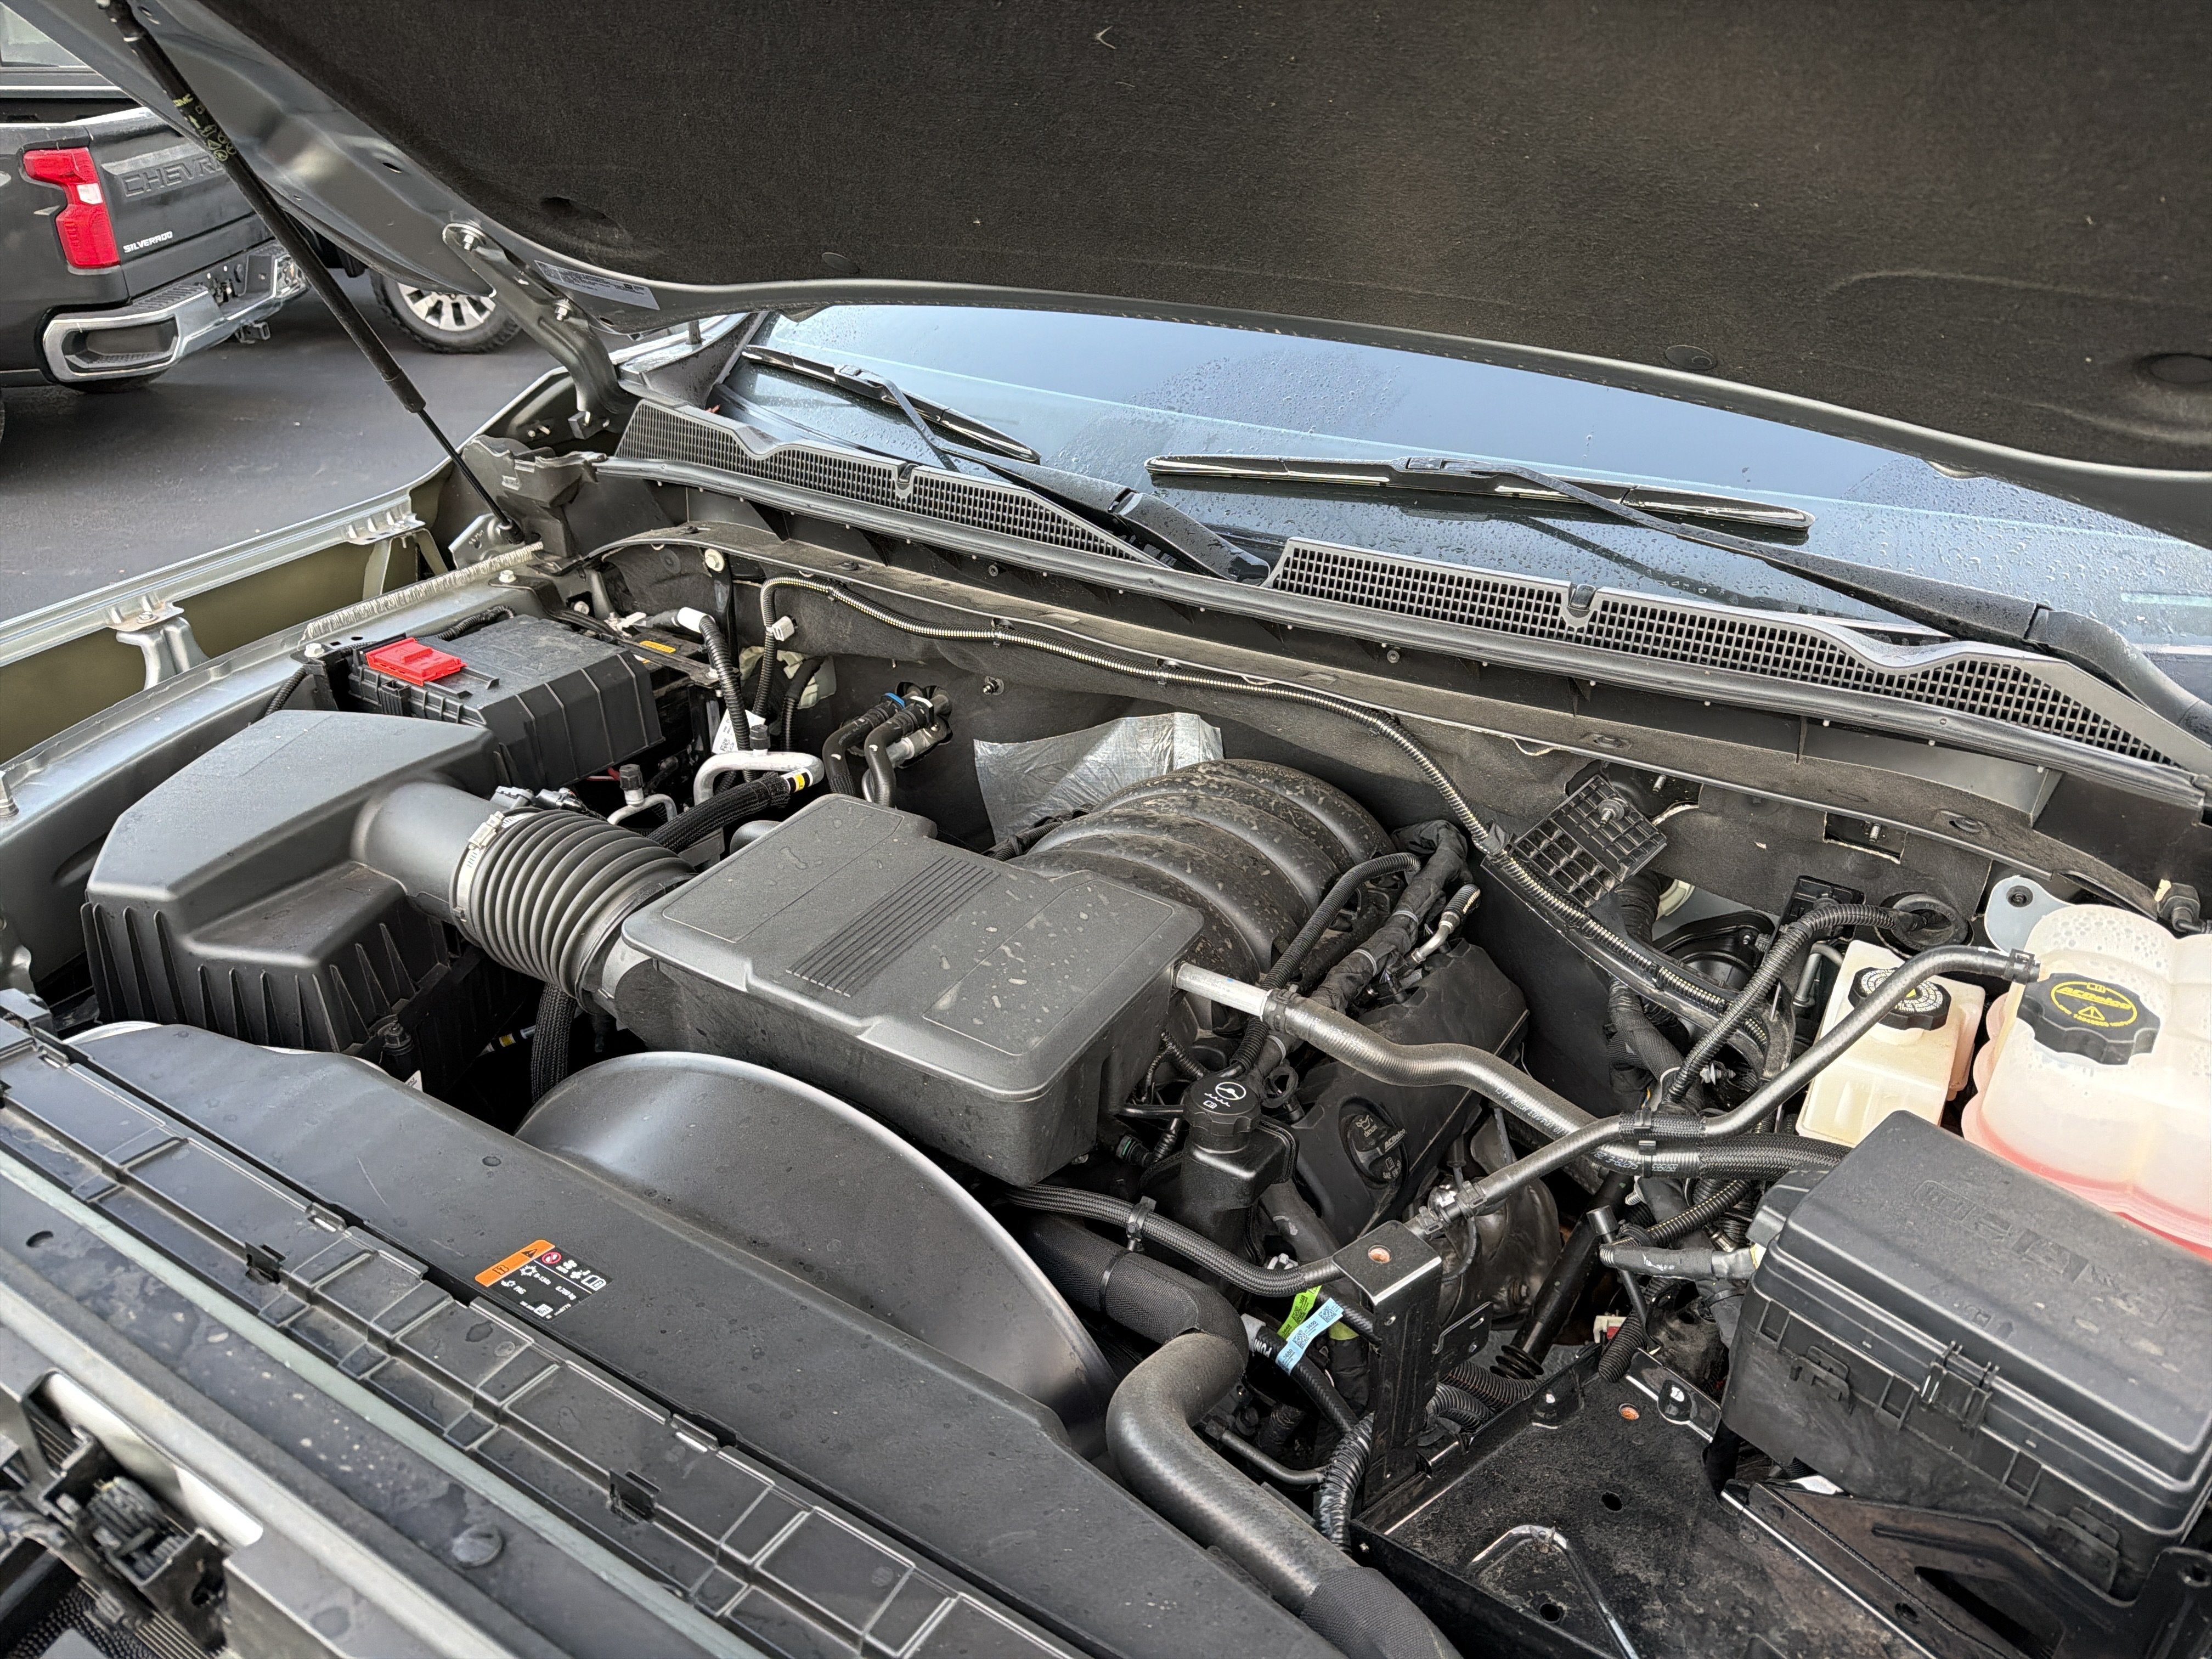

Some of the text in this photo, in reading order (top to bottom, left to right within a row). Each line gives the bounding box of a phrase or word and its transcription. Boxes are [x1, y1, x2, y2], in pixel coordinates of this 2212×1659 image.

[123, 231, 173, 253] SILVERADO
[2058, 987, 2131, 1009] ACDelco
[1364, 1124, 1378, 1138] dexos
[1385, 1128, 1406, 1149] ACDelco
